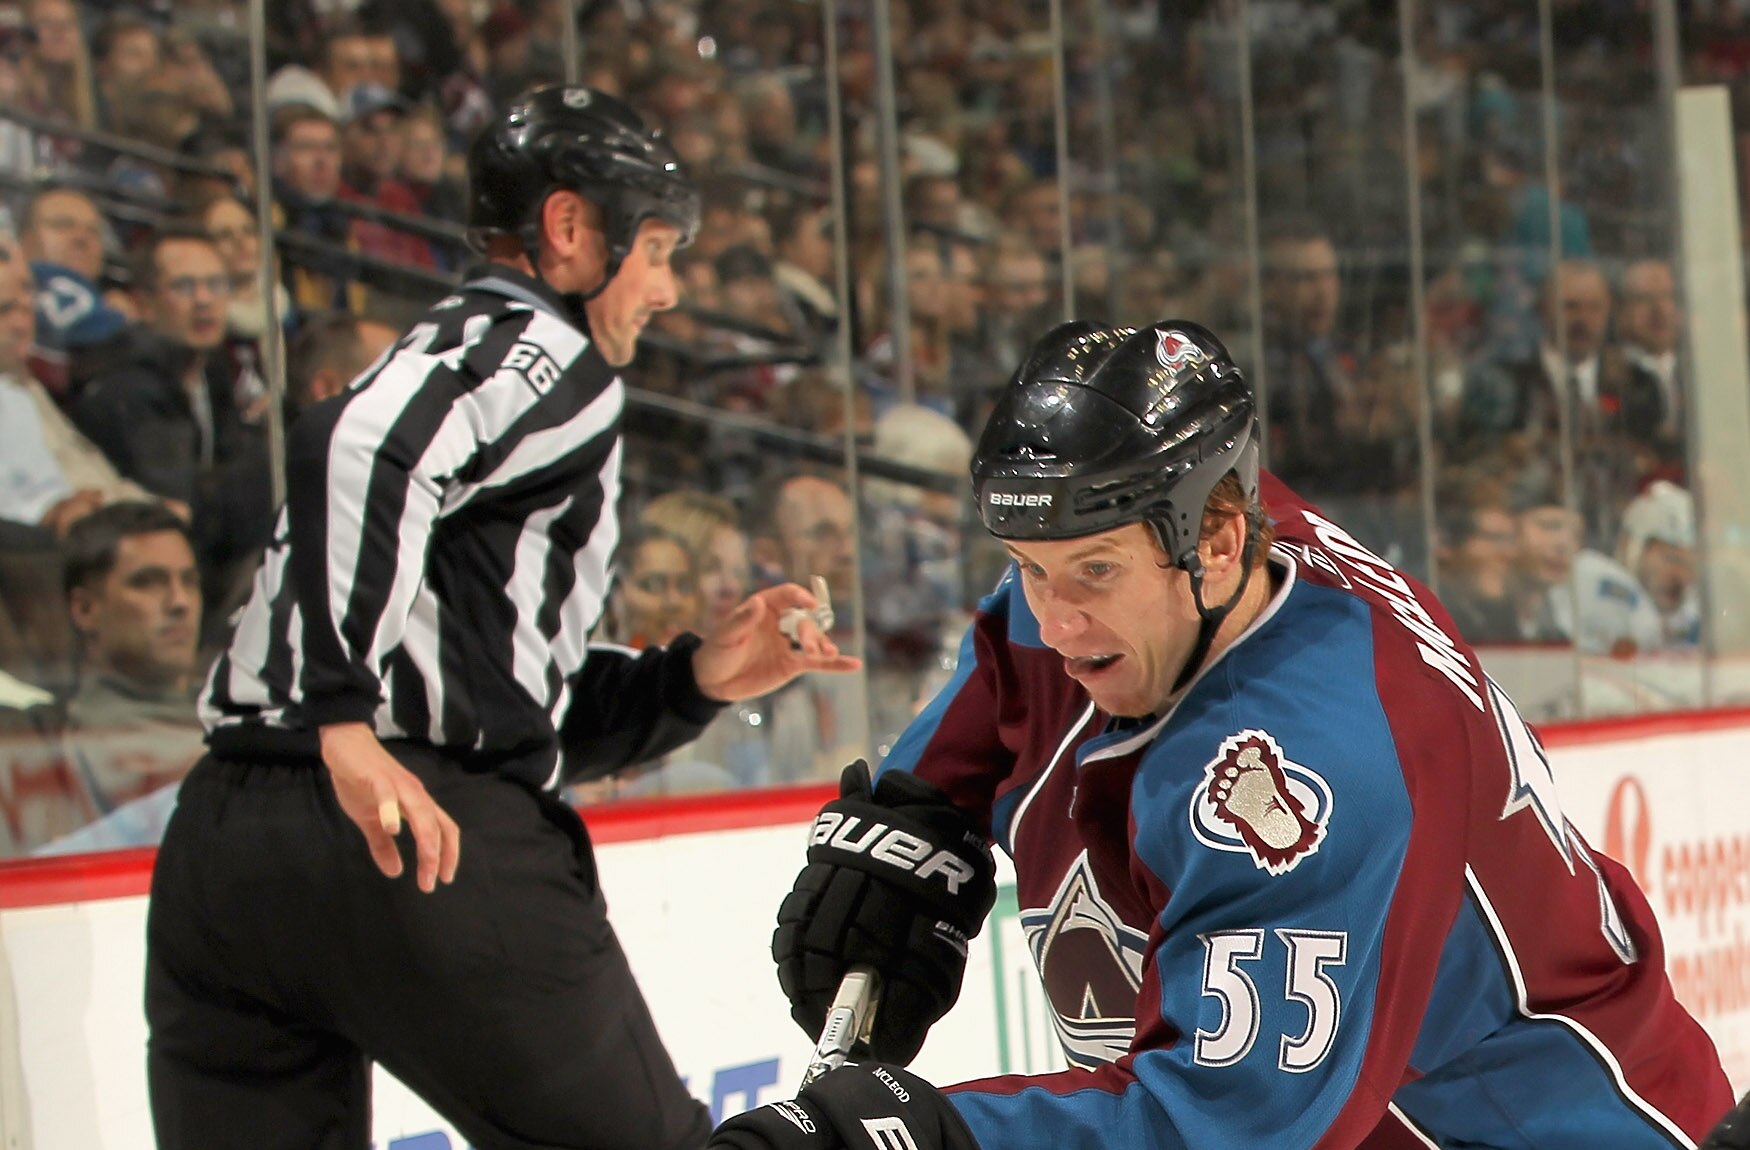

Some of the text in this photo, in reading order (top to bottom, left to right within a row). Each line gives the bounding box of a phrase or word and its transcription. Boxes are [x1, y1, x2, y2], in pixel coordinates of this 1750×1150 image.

[989, 493, 1053, 507] BAUER
[809, 811, 976, 896] AUER
[1193, 928, 1348, 1075] 55
